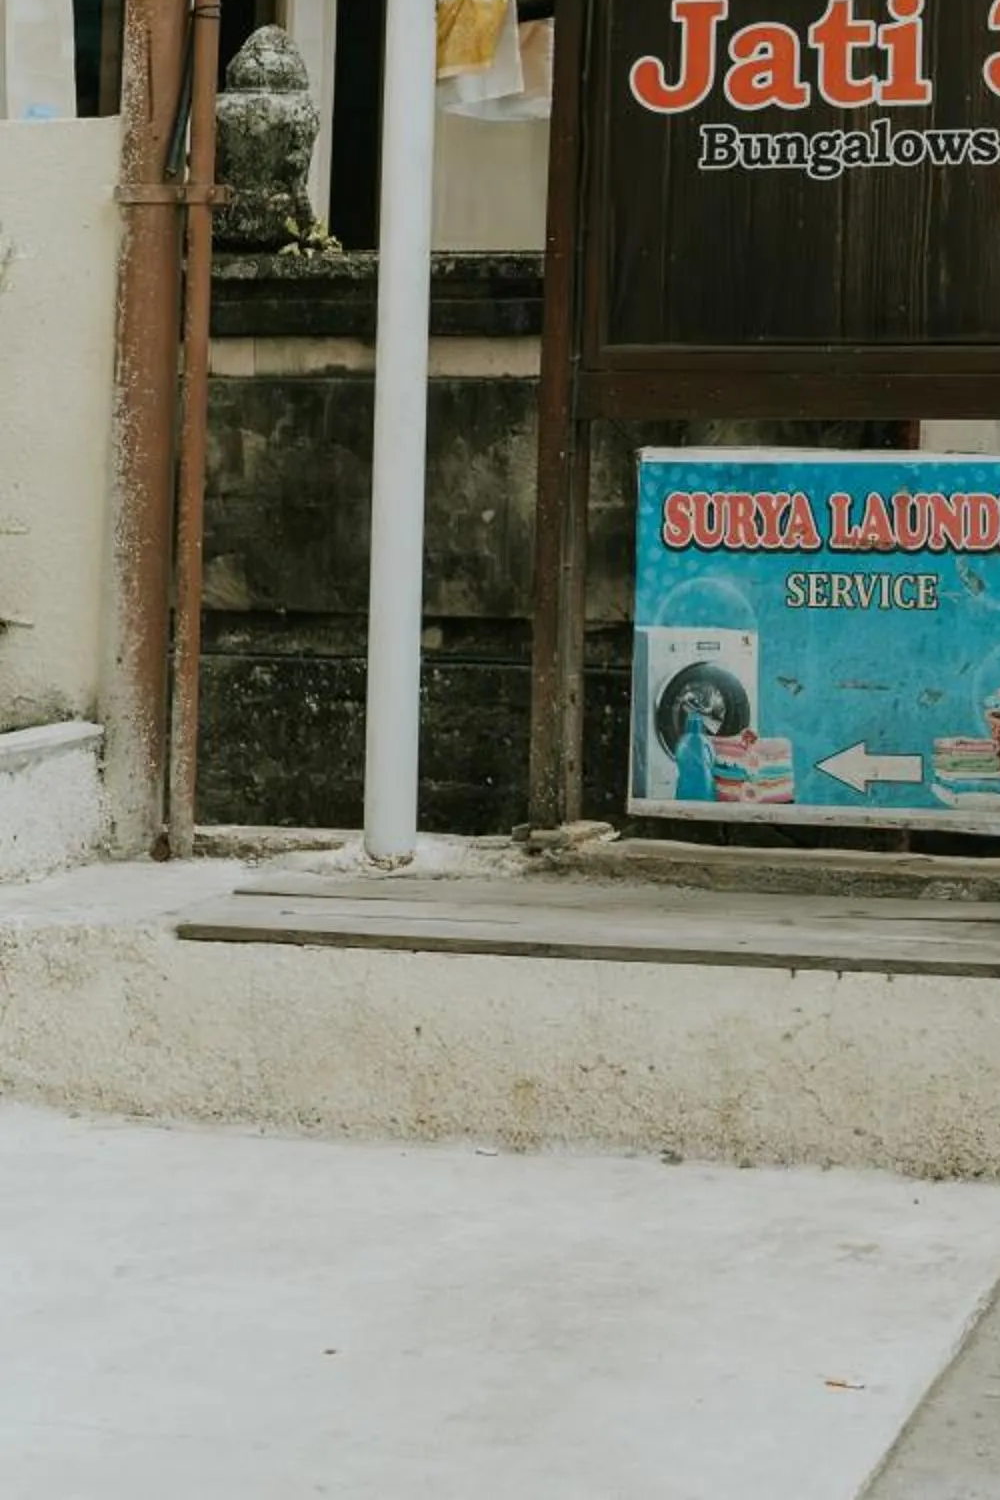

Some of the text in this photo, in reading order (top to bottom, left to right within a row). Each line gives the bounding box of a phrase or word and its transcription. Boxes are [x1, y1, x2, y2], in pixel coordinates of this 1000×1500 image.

[699, 119, 1000, 180] Bungalows
[663, 491, 821, 552] SURYA
[786, 572, 939, 610] SERVICE
